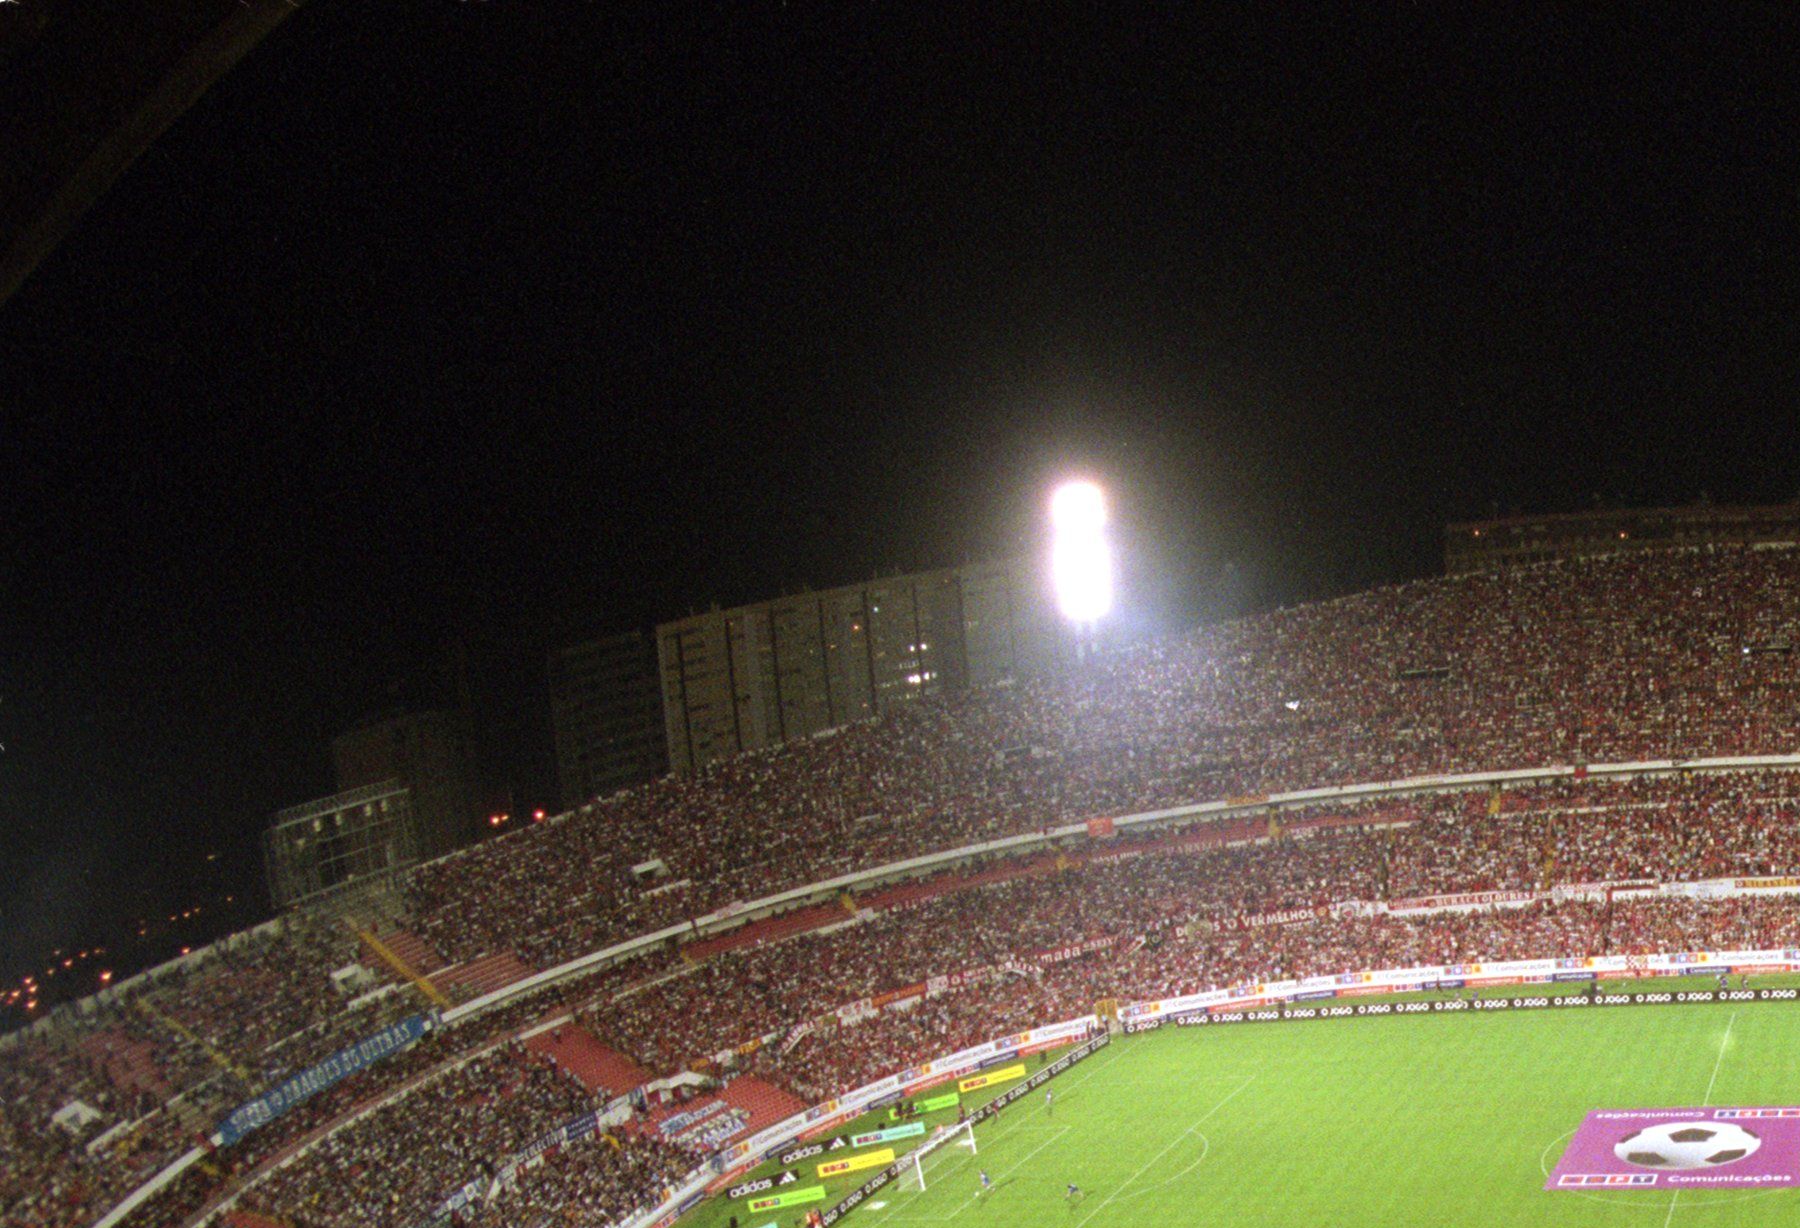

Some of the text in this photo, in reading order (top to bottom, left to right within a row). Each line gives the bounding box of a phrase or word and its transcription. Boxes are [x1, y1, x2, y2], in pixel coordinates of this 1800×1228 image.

[1241, 909, 1315, 928] VERMELHOS
[1594, 994, 1630, 1004] O JOGO
[1635, 992, 1672, 1003] O JOGO
[1677, 991, 1713, 1002] O JOGO
[1719, 989, 1755, 1000] O JOGO
[1761, 988, 1797, 999] O JOGO
[1434, 1000, 1443, 1010] O
[1473, 998, 1508, 1009] O JOGO
[1513, 997, 1548, 1007] O JOGO
[1554, 995, 1589, 1006] O JOGO
[1320, 1005, 1353, 1017] O JOGO
[1357, 1003, 1390, 1014] O JOGO
[1395, 1001, 1429, 1012] O JOGO
[1213, 1012, 1243, 1023] O JOGO
[1248, 1010, 1279, 1021] O JOGO
[1283, 1007, 1315, 1019] O JOGO
[1178, 1014, 1208, 1025] O JOGO
[1127, 1018, 1158, 1033] O JOGO
[783, 1143, 824, 1164] adidas
[1667, 1174, 1792, 1184] Comunicações
[730, 1178, 773, 1199] adidas
